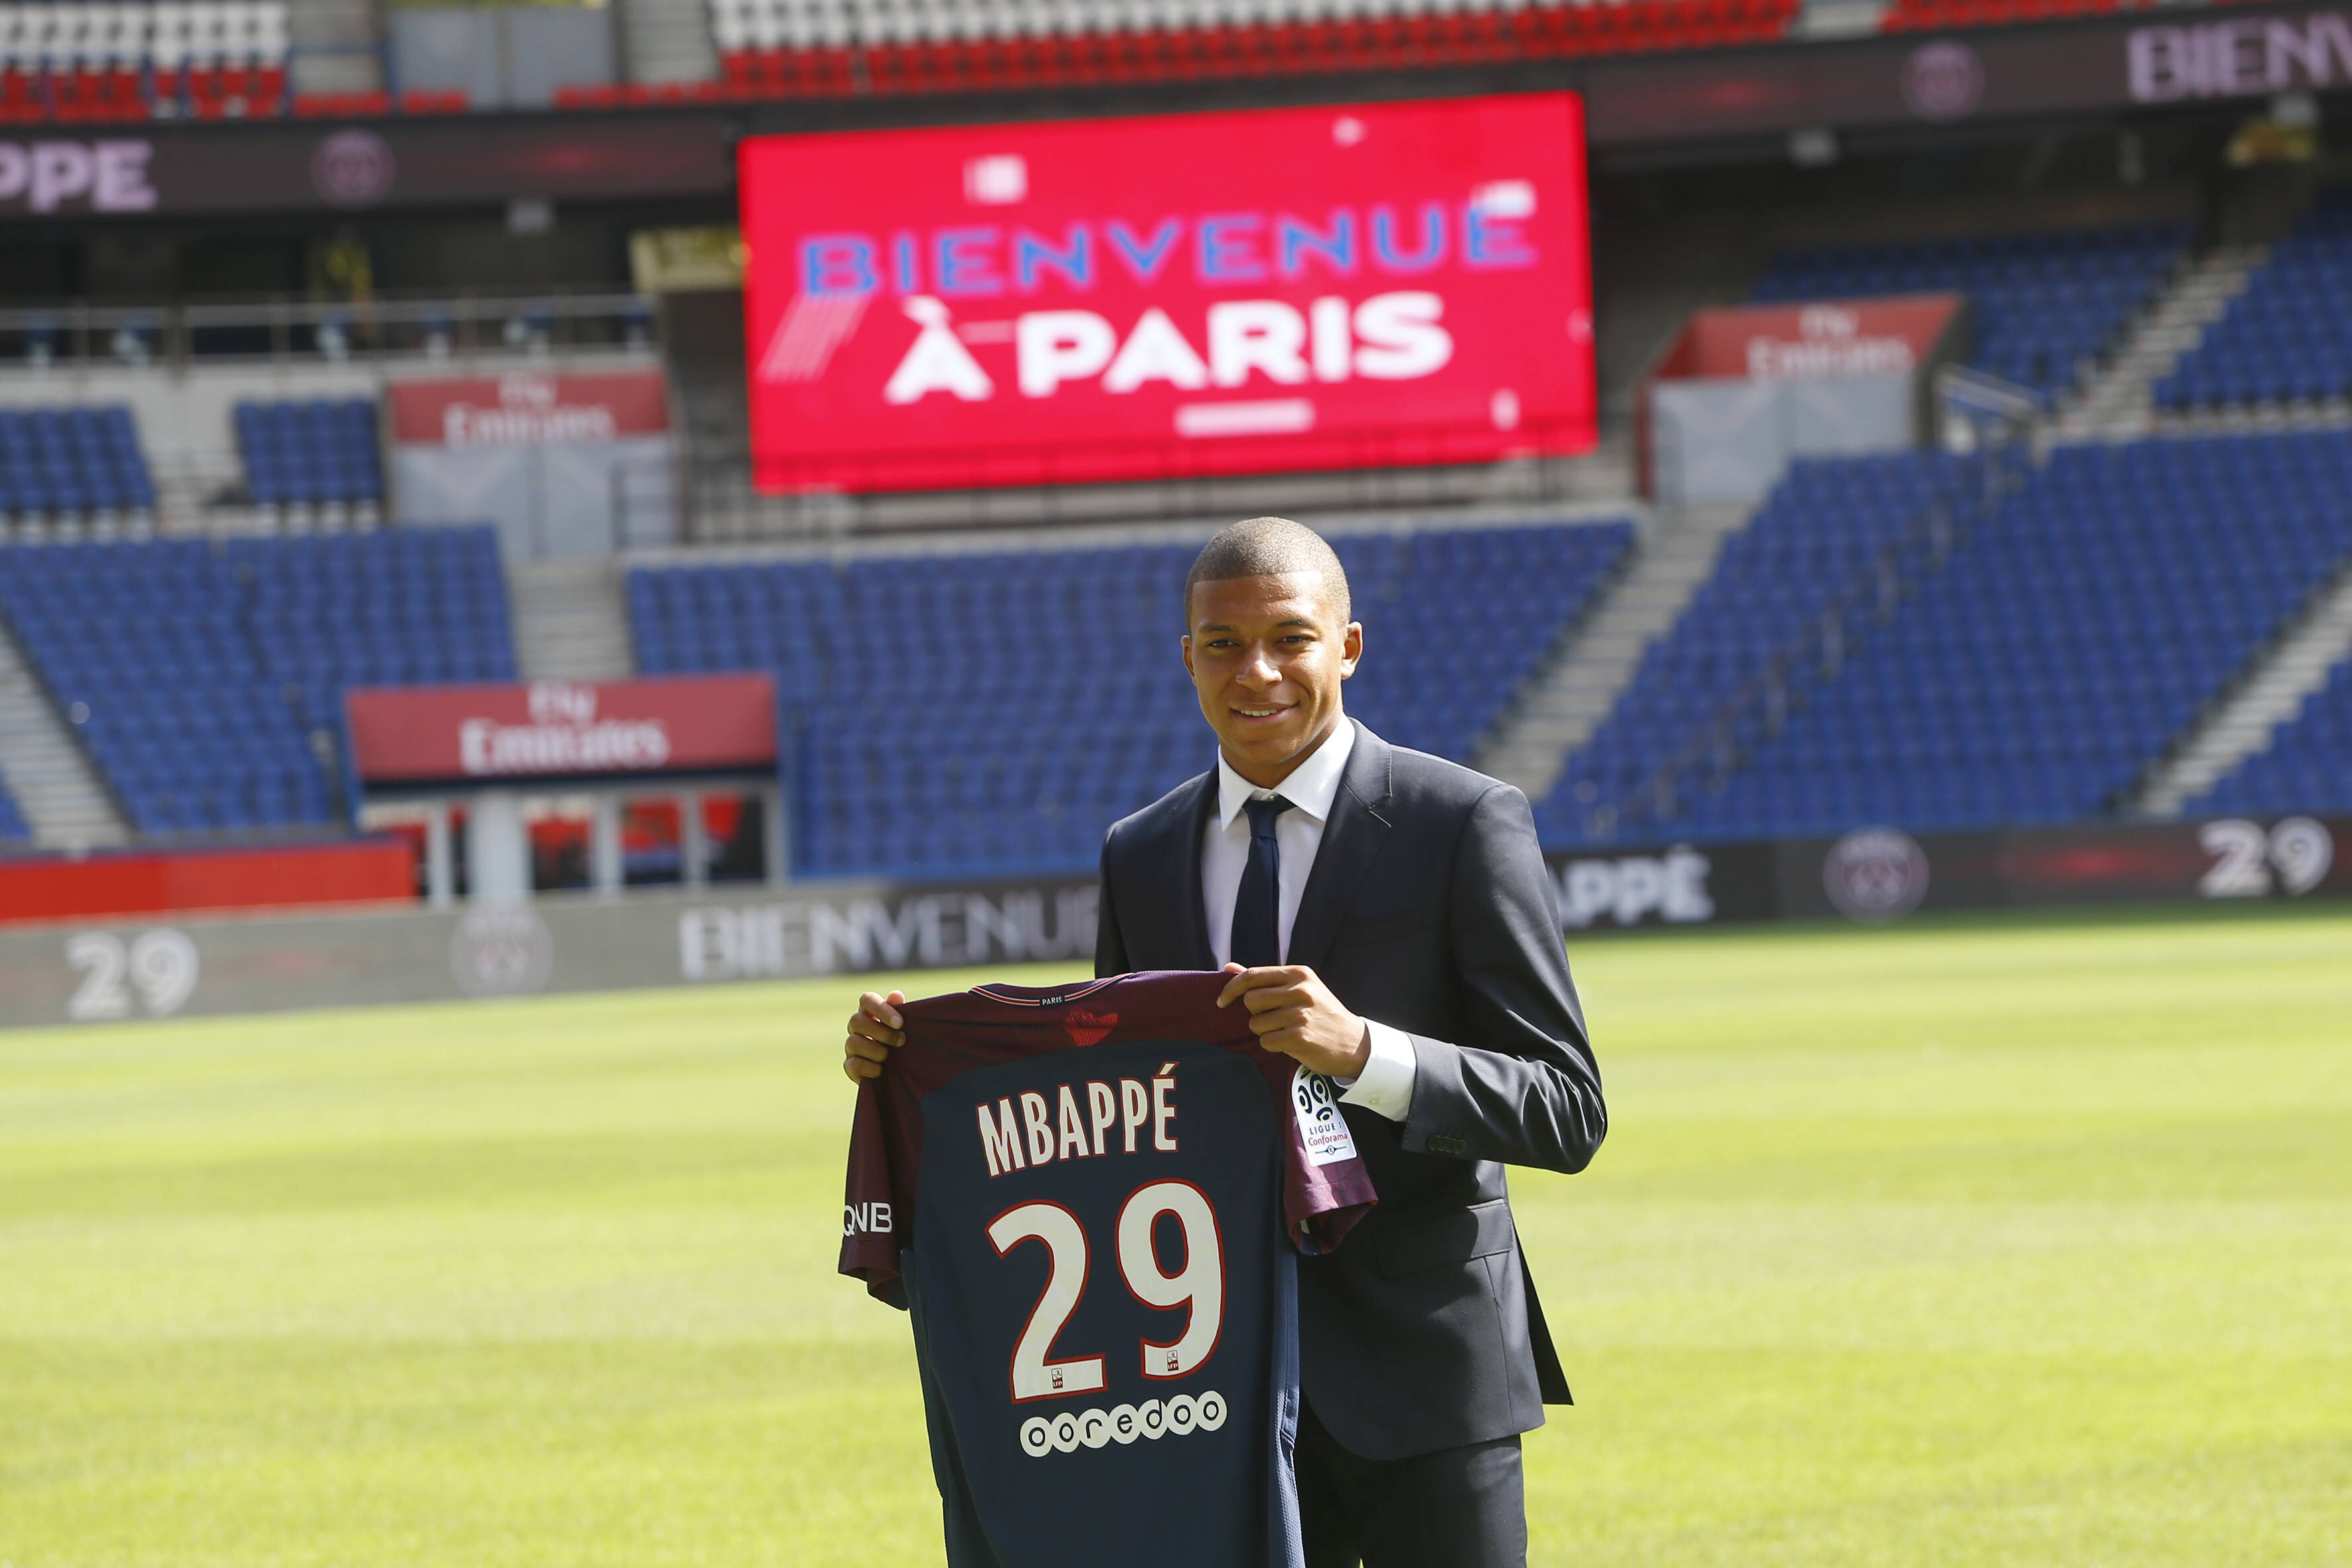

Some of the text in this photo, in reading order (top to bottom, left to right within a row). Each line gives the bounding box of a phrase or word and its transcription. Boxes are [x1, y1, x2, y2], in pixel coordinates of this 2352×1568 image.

[801, 203, 1539, 299] BIENVENUE
[885, 290, 1454, 405] À PARIS
[459, 718, 671, 775] Emirates
[1551, 842, 1715, 927] PPÉ
[2197, 817, 2334, 896] 29
[63, 929, 200, 1020] 29
[1042, 996, 1062, 1006] PARIS
[977, 1061, 1179, 1178] MBAPPÉ
[1308, 1133, 1348, 1146] Conforama
[1309, 1123, 1336, 1135] LIGUE
[843, 1202, 893, 1237] QNB
[986, 1178, 1226, 1403] 29
[1026, 1397, 1221, 1449] ooredoo
